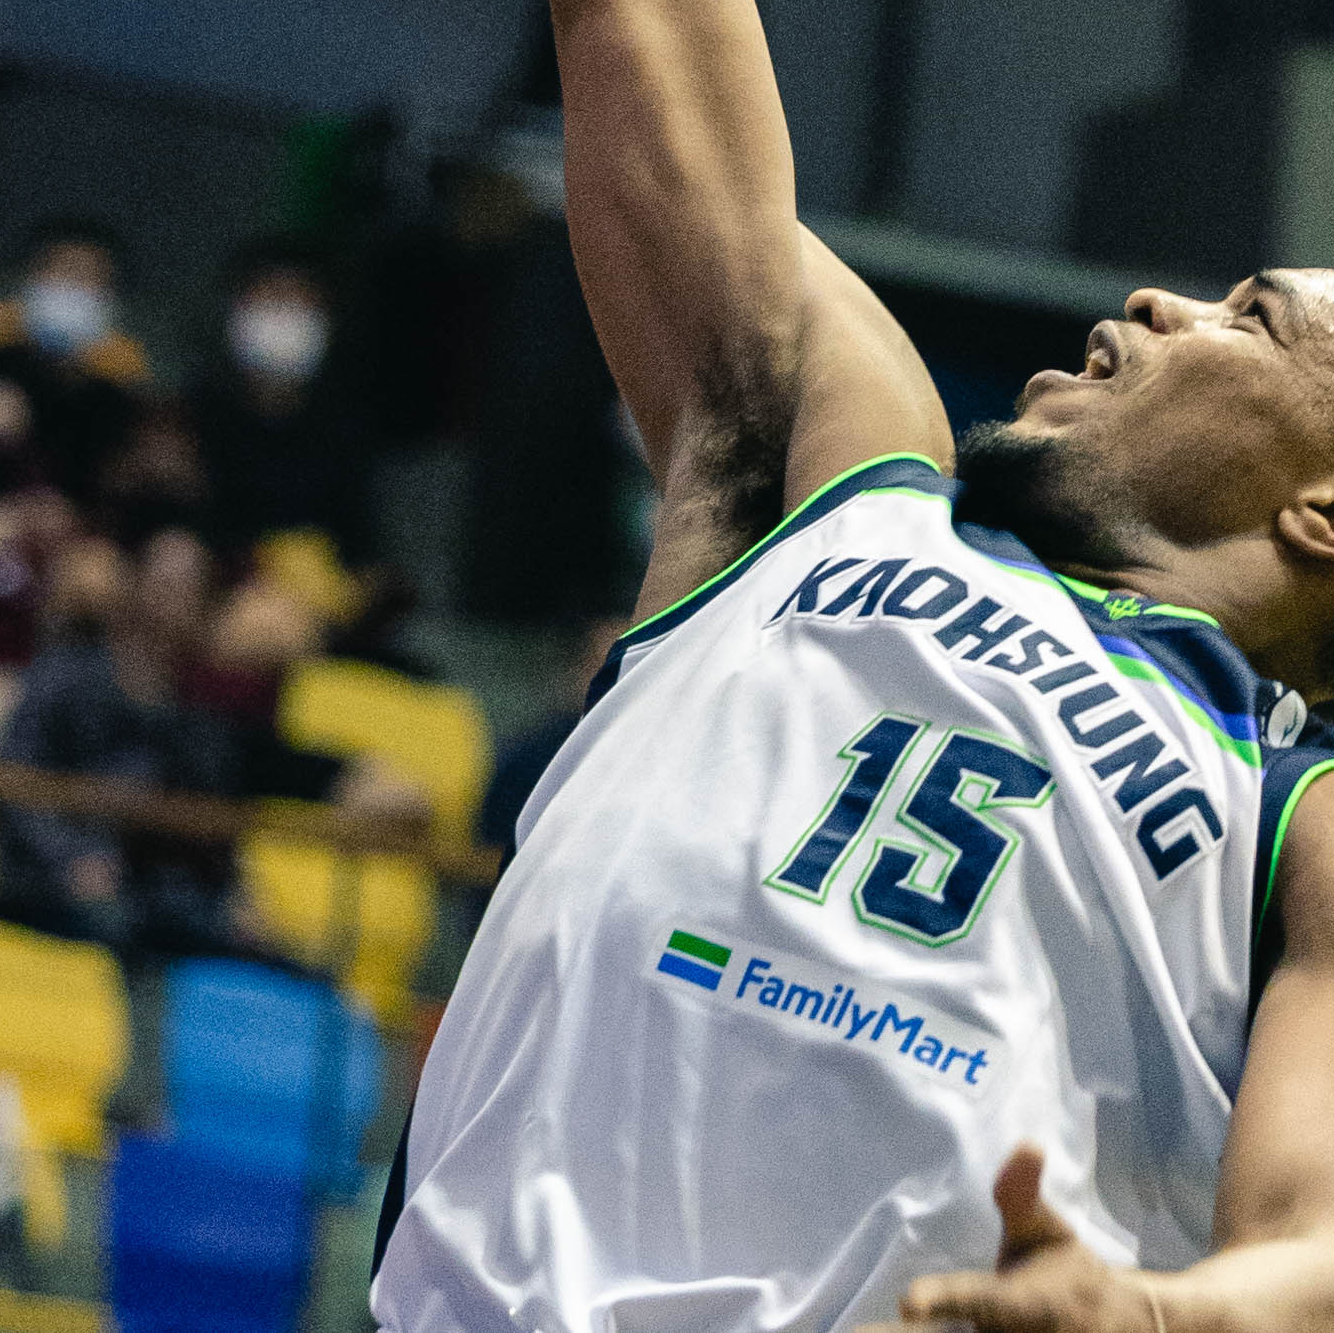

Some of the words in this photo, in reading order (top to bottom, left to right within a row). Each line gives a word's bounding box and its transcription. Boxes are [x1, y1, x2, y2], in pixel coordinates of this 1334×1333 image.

[763, 712, 1058, 948] 15
[771, 556, 1224, 882] KAOHSIUNG
[734, 956, 989, 1087] FamilyMart
